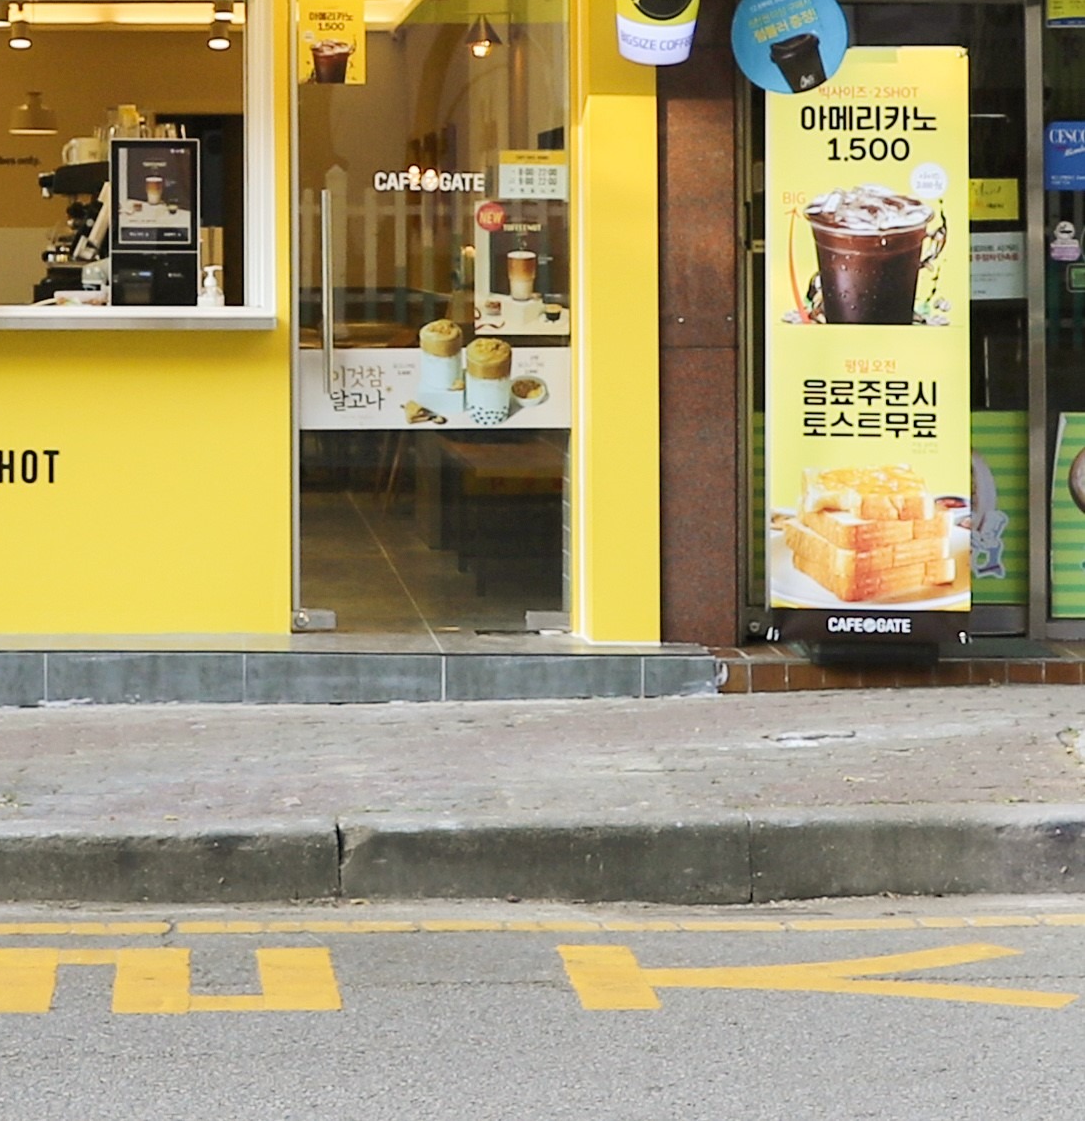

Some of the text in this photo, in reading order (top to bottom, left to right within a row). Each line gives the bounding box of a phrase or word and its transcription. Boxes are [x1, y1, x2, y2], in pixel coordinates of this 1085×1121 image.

[800, 105, 938, 131] 아메리카노
[827, 138, 911, 162] 1.500
[374, 171, 486, 192] CAFE GATE
[782, 191, 807, 205] BIG
[478, 209, 504, 225] NEW
[844, 359, 896, 373] 평일 오전
[329, 388, 386, 412] 달고나
[803, 379, 938, 407] 음료주문시
[803, 411, 938, 439] 토스트무료
[827, 616, 912, 634] CAFE GATE
